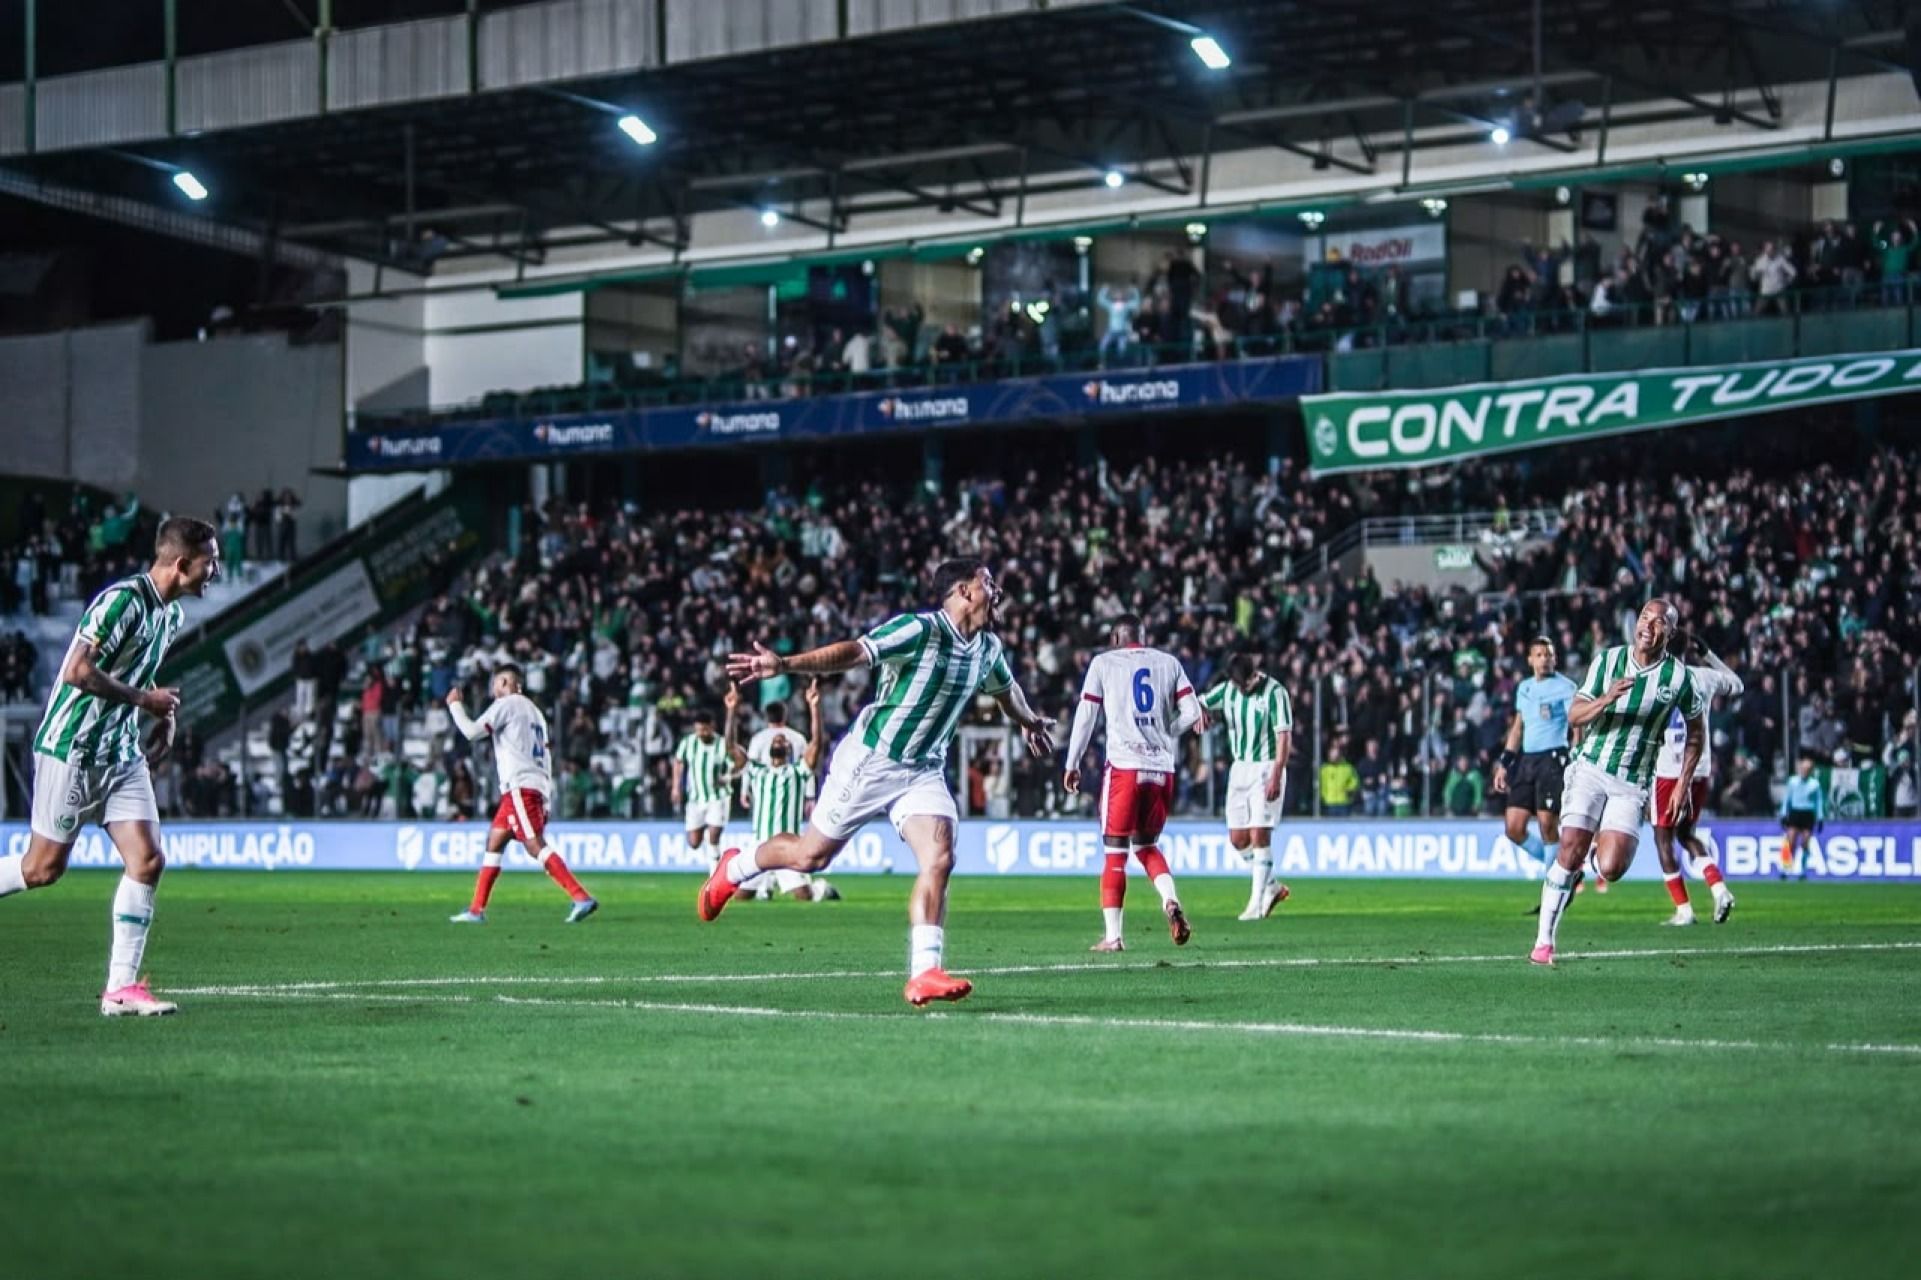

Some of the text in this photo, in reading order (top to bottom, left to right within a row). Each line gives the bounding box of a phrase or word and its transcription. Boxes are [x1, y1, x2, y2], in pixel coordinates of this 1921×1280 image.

[1348, 359, 1896, 458] CONTRA TUDO
[1133, 668, 1155, 713] 6
[8, 832, 105, 864] CRA
[161, 825, 315, 870] NIPULAÇÃO
[431, 831, 487, 865] CBF
[507, 831, 627, 865] CNTRA
[629, 831, 656, 865] A
[1028, 831, 1098, 869] CBF
[1281, 834, 1311, 872] A
[1726, 836, 1921, 877] BRASIL
